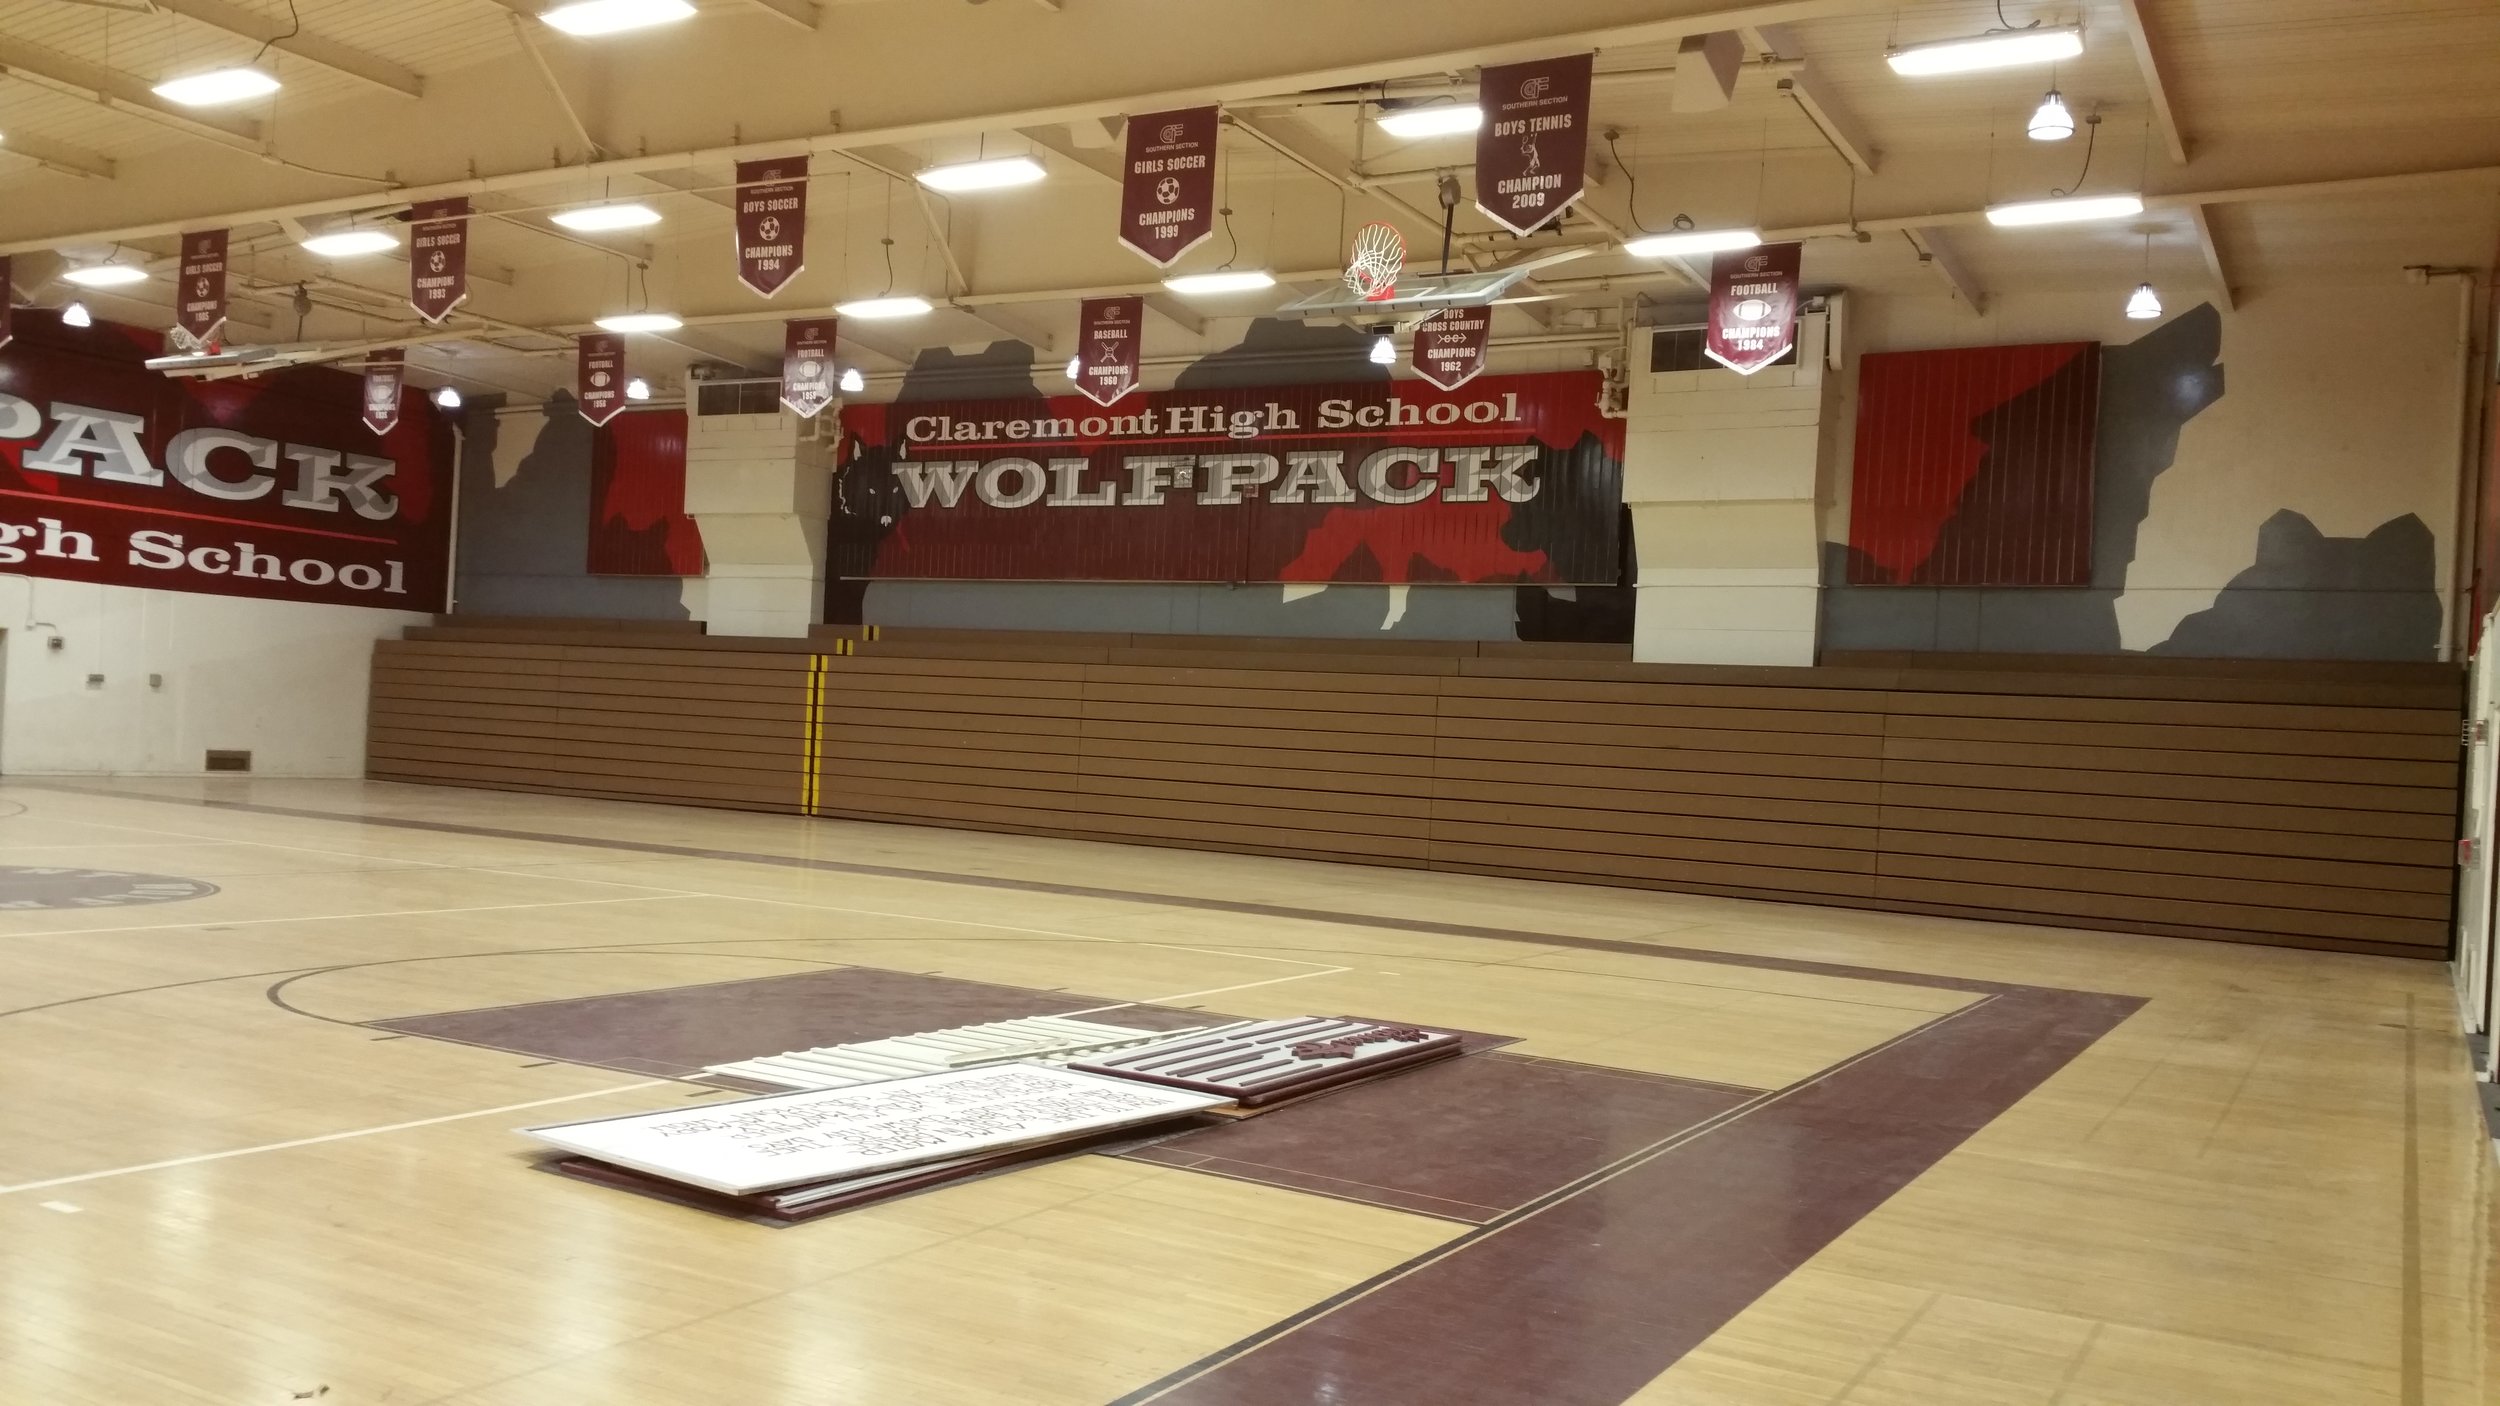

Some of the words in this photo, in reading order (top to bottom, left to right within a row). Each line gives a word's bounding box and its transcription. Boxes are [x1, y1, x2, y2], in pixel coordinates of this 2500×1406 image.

[1502, 101, 1538, 110] SOUTHERN
[1539, 96, 1568, 106] SECTION
[1495, 119, 1526, 137] BOYS
[1530, 114, 1572, 132] TENNIS
[1146, 145, 1174, 153] SOUTHERN
[1176, 142, 1198, 150] SECTION
[1134, 160, 1164, 174] GIRLS
[1167, 155, 1206, 170] SOCCER
[1498, 174, 1562, 194] CHAMPION
[744, 200, 765, 213] BOYS
[768, 198, 798, 211] SOCCER
[1512, 192, 1545, 208] 2009
[1139, 208, 1195, 226] CHAMPIONS
[1155, 225, 1178, 239] 1999
[416, 236, 435, 248] GIRLS
[437, 233, 460, 246] SOCCER
[745, 245, 793, 258] CHAMPIONS
[758, 259, 780, 271] 1994
[417, 276, 454, 288] CHAMPIONS
[1730, 283, 1778, 296] FOOTBALL
[1444, 309, 1464, 319] BOYS
[1423, 321, 1447, 332] CROSS
[1450, 320, 1484, 331] COUNTRY
[1722, 326, 1780, 339] CHAMPIONS
[1094, 329, 1127, 339] BASEBALL
[1737, 339, 1763, 350] 1984
[797, 349, 824, 358] FOOTBALL
[1428, 348, 1476, 359] CHAMPIONS
[589, 360, 613, 369] FOOTBALL
[1089, 366, 1128, 376] CHAMPIONS
[1441, 362, 1462, 372] 1962
[1100, 376, 1117, 385] 1960
[584, 390, 614, 400] CHAMPIONS
[906, 408, 1158, 441] Claremont
[1165, 402, 1300, 439] High
[1318, 392, 1521, 429] School
[891, 446, 1541, 508] WOLFPACK
[128, 530, 408, 594] School
